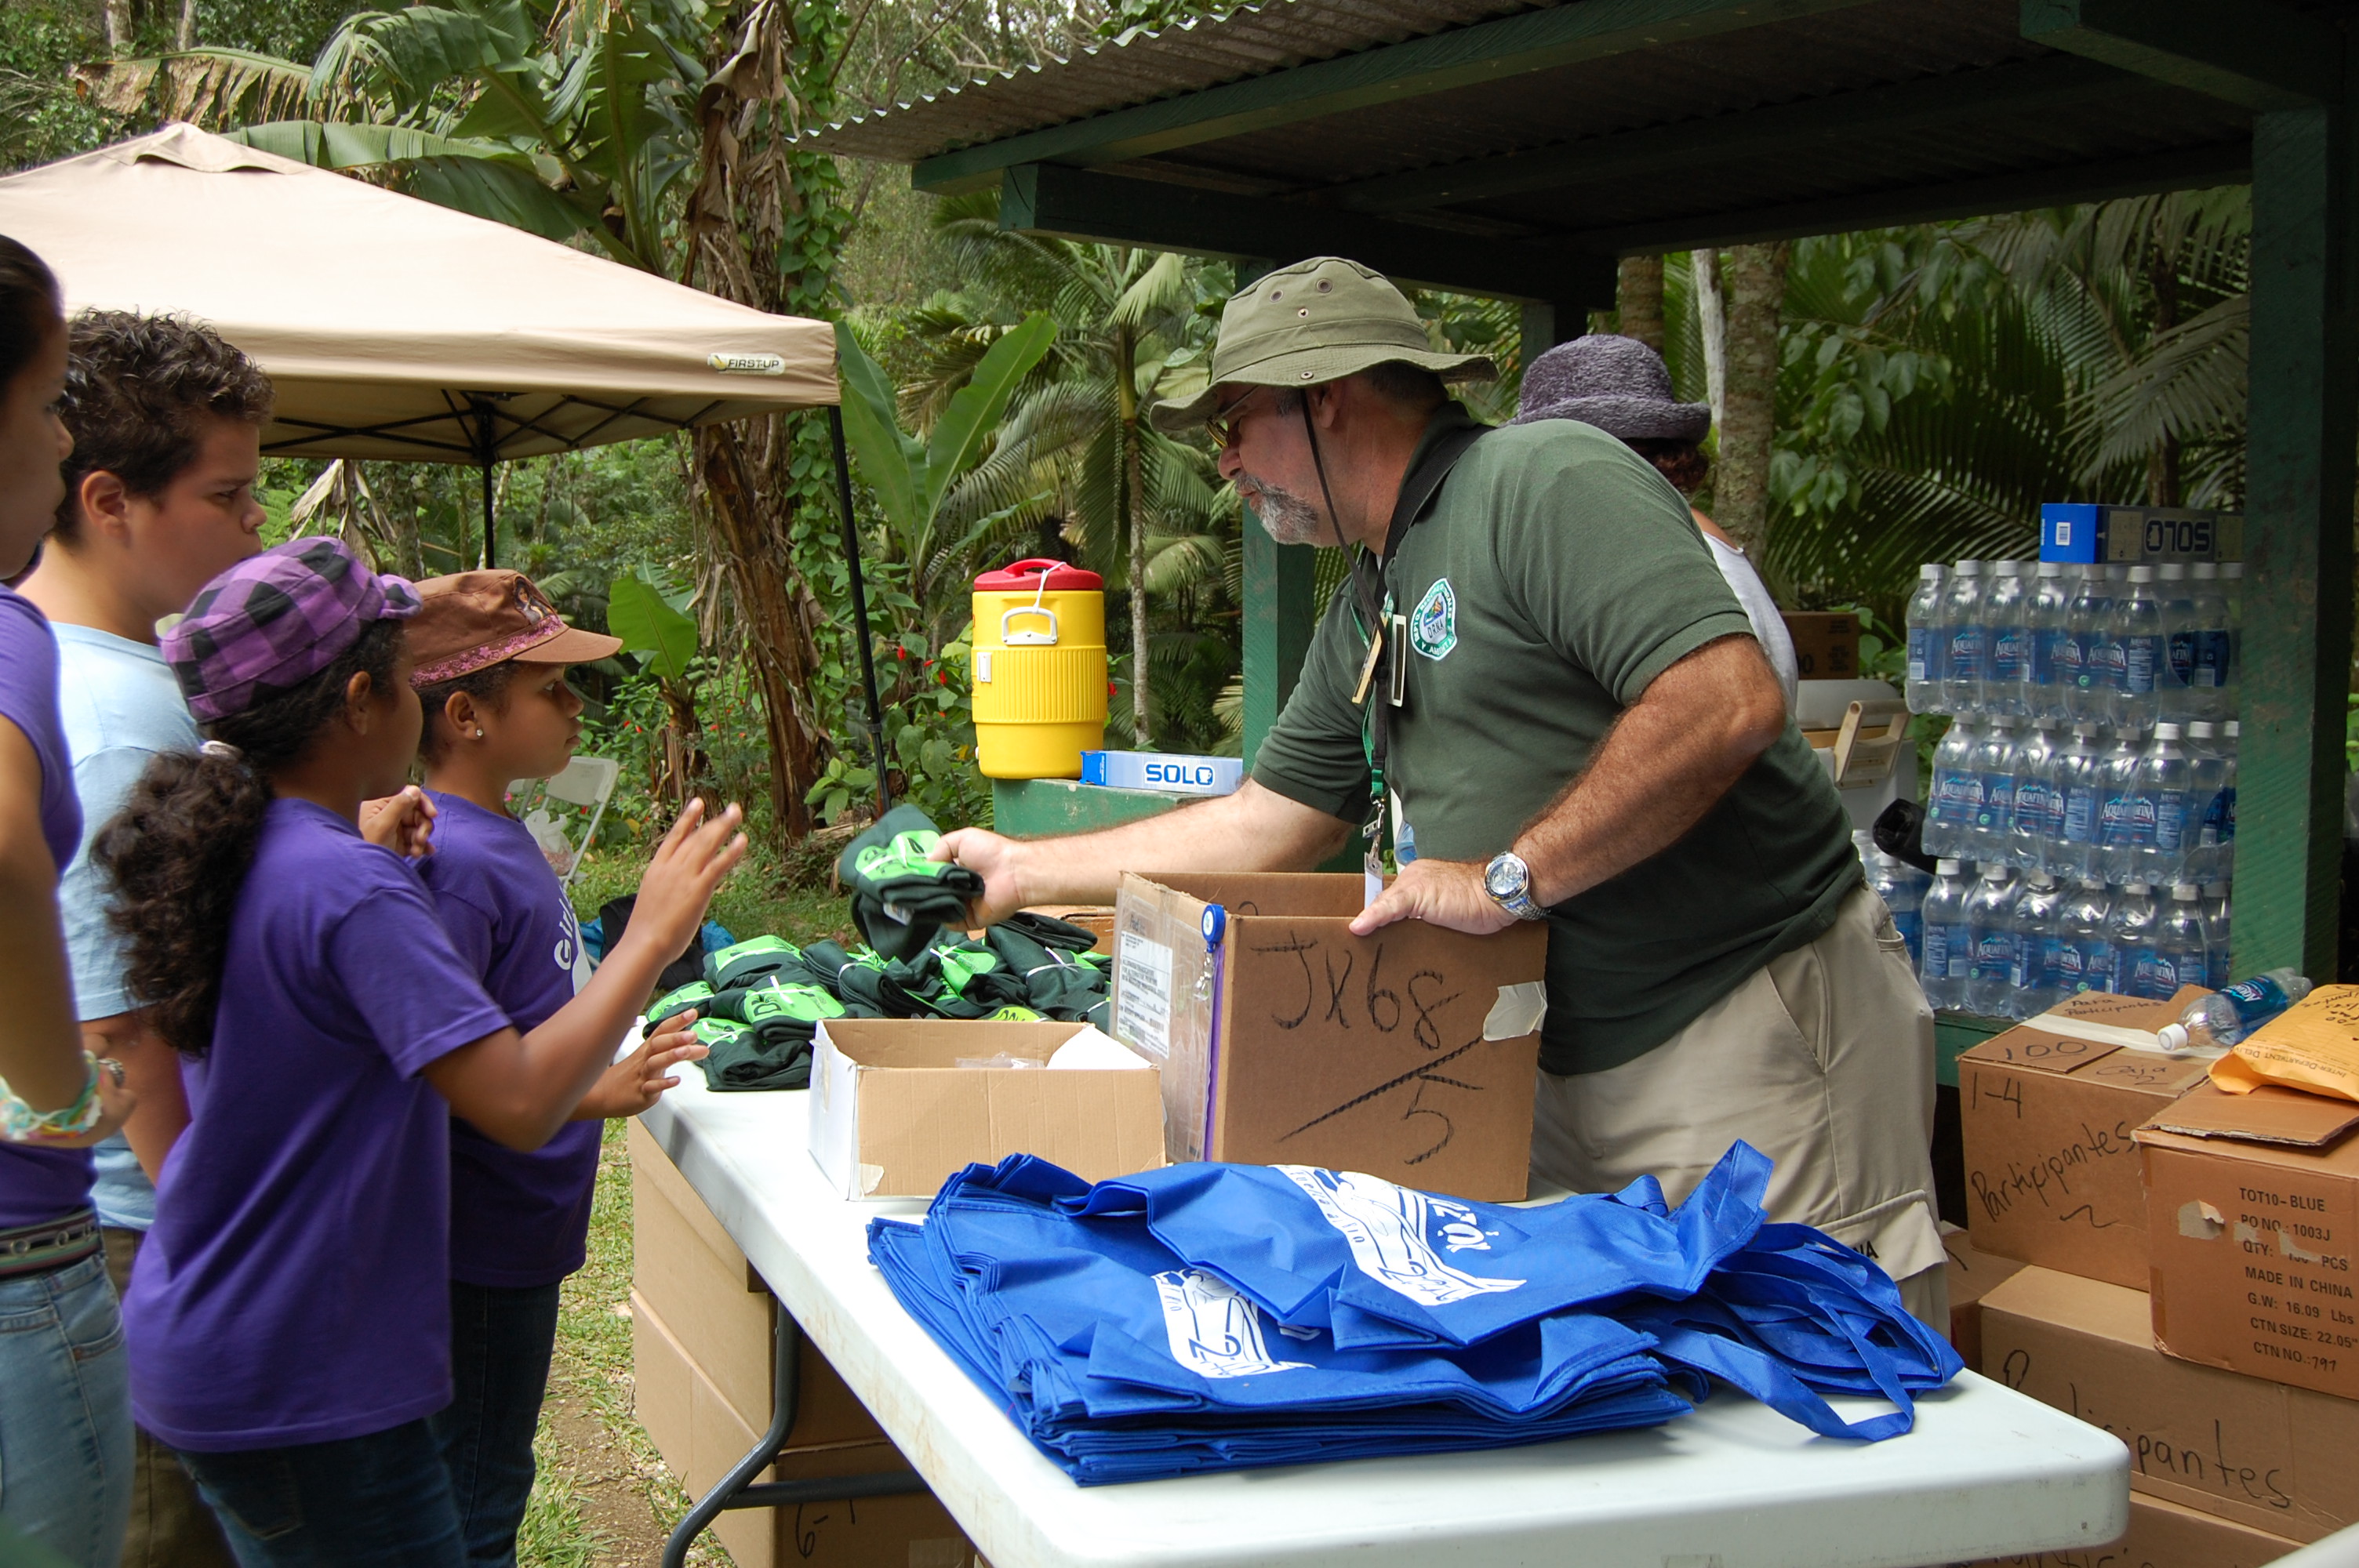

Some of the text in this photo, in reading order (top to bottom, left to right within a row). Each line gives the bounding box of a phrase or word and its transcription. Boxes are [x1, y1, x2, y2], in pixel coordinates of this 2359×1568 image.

[2146, 520, 2211, 553] SOLO
[1145, 764, 1213, 786] SOLO
[2005, 1041, 2088, 1060] 100
[2095, 1064, 2168, 1076] Caja
[1972, 1071, 2023, 1119] 1-4
[1970, 1120, 2137, 1223] Participantes
[2240, 1214, 2259, 1229] PO
[2293, 1223, 2331, 1242] 1003J
[2243, 1240, 2274, 1258] QTY:
[2321, 1254, 2349, 1272] PCS
[2245, 1265, 2354, 1299] MADE IN CHINA
[2247, 1291, 2355, 1325] G.W: 16.09 Lbs
[2250, 1316, 2277, 1333] CTN
[2279, 1323, 2313, 1341] SIZE:
[2253, 1341, 2281, 1359] CTN
[2002, 1348, 2292, 1509] Ppantes
